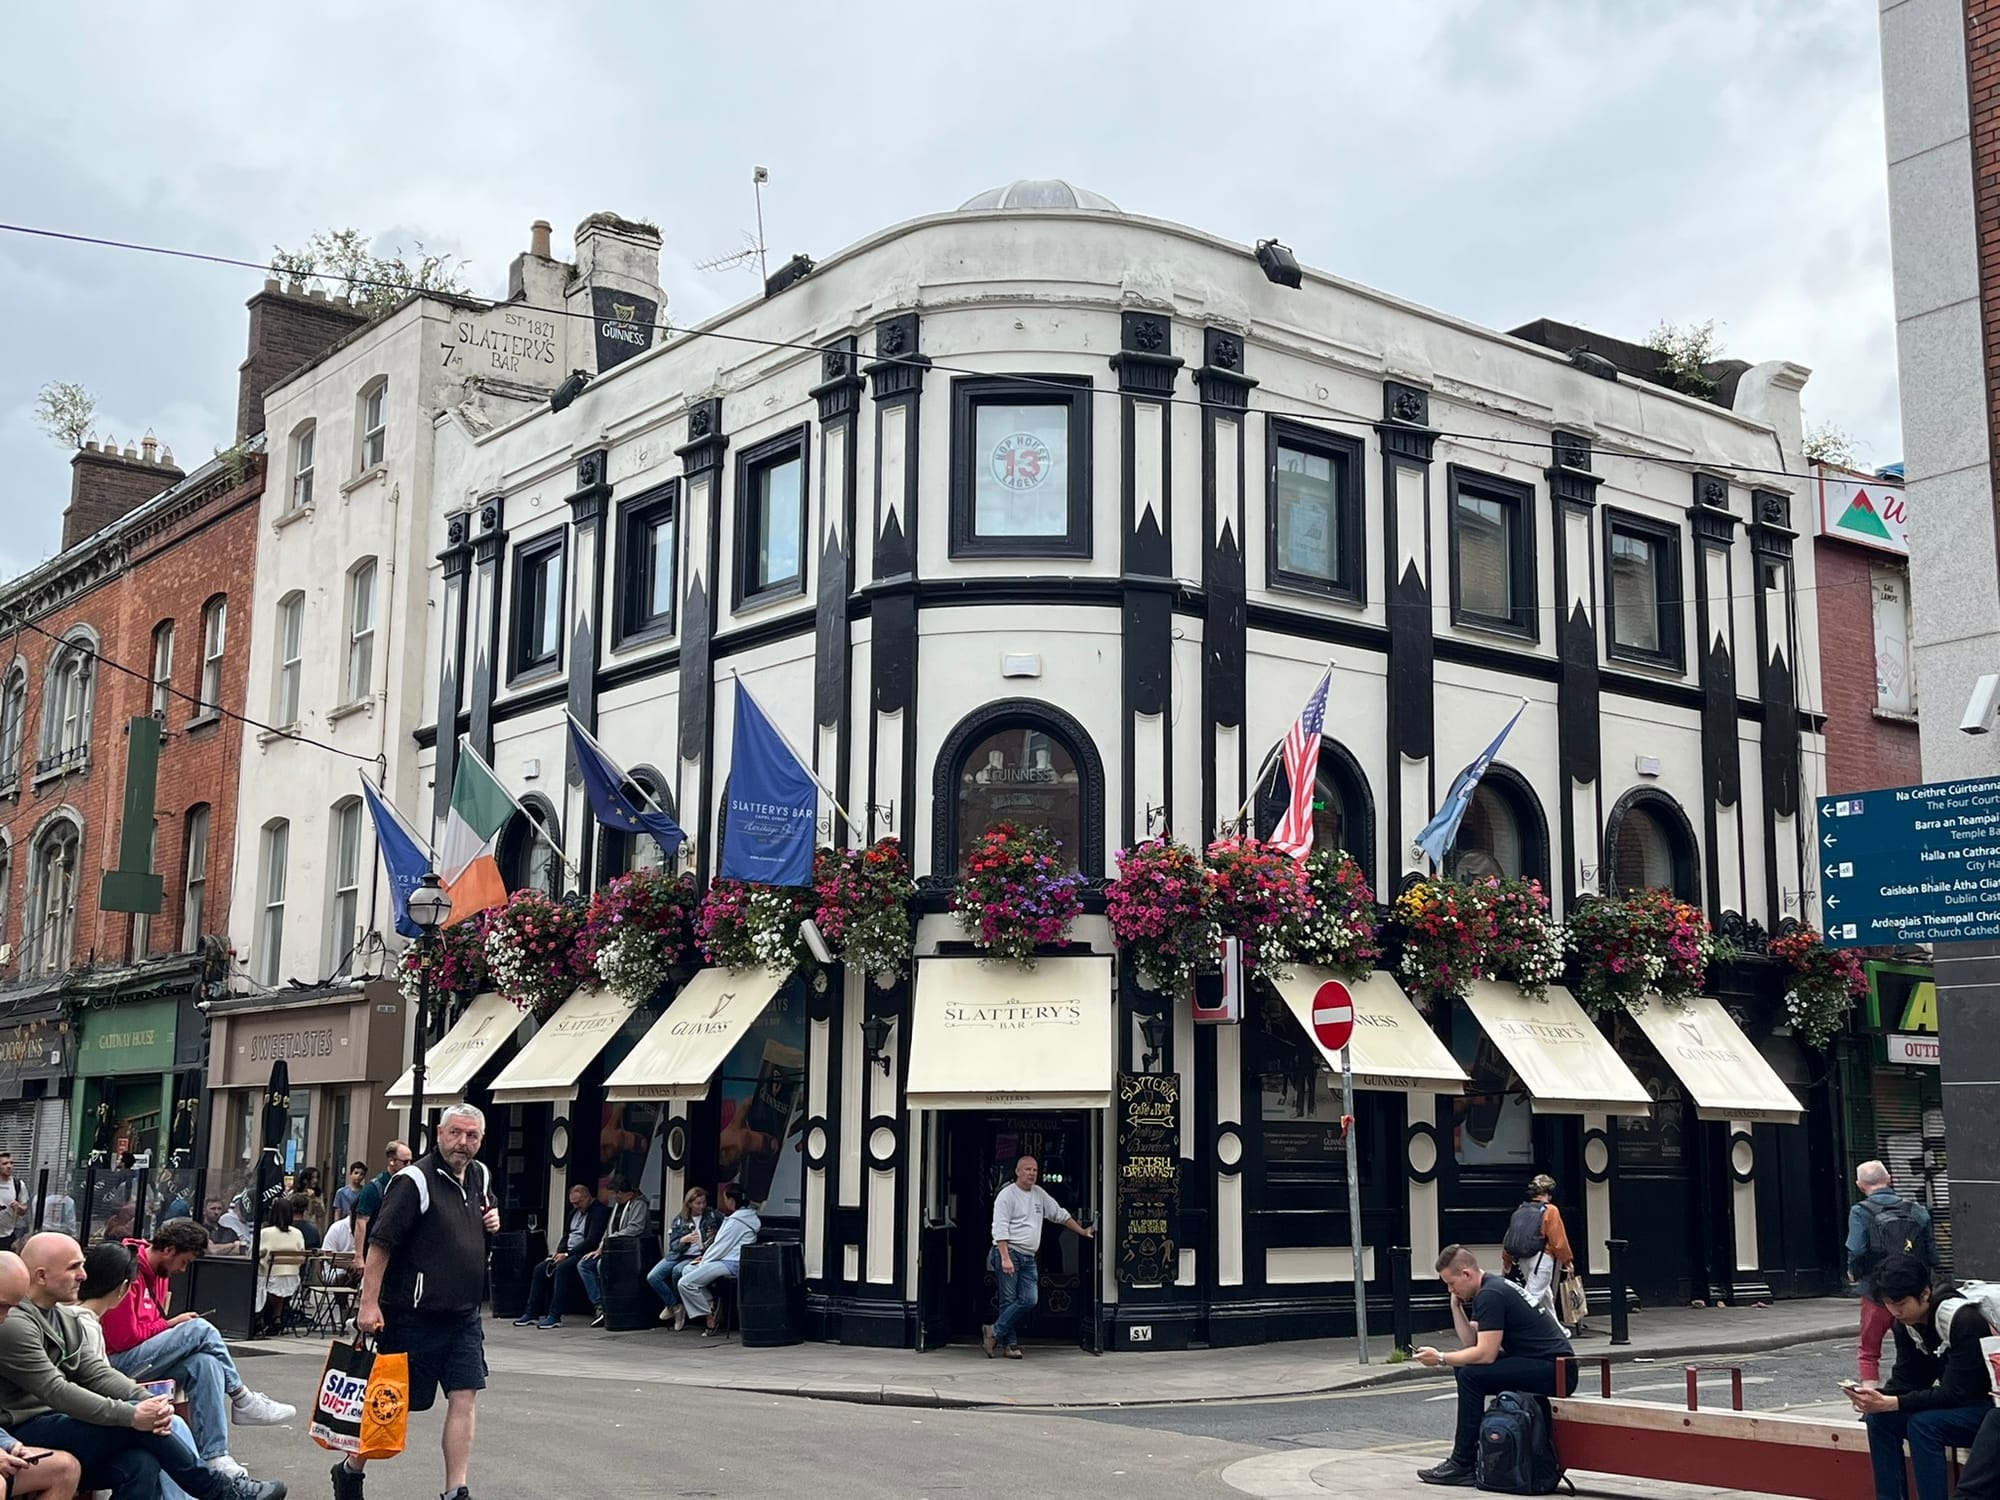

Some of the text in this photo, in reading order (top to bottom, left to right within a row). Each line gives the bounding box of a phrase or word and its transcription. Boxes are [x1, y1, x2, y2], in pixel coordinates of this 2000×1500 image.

[528, 320, 555, 339] 1821
[602, 323, 644, 346] GUINNESS
[458, 322, 556, 364] SLATTERY'S
[491, 352, 519, 373] BAR
[996, 436, 1048, 463] HOP HOUSE
[1003, 449, 1040, 477] 13
[1002, 474, 1039, 487] LAGER
[990, 768, 1050, 782] GUINNESS
[1896, 791, 1909, 801] Na
[1912, 788, 1946, 799] Ceithre
[732, 800, 813, 819] SLATTERY'S BAR
[1926, 801, 1944, 810] The
[1947, 798, 1969, 808] Four
[1915, 820, 1941, 830] Barra
[1943, 819, 1955, 827] an
[1951, 828, 1986, 840] Temple
[1920, 850, 1945, 861] Halla
[1948, 850, 1960, 859] na
[1966, 861, 1985, 872] City
[1880, 884, 1919, 896] Caisleán
[1921, 882, 1951, 893] Bhaile
[1953, 879, 1977, 891] Átha
[1945, 894, 1977, 904] Dublin
[1871, 915, 1921, 929] Ardeaglais
[1923, 912, 1974, 926] Theampall
[1898, 924, 1999, 940] Christ Church Cathed
[945, 1006, 1080, 1021] SLATTERY'S
[1899, 982, 1938, 1031] A
[556, 1016, 617, 1032] SLATTERY'S
[671, 1021, 728, 1036] GUINNESS
[1353, 1014, 1399, 1028] NNESS
[1499, 1024, 1584, 1039] SLATTERY'S
[99, 1030, 155, 1049] GATEWAY HOUSE
[251, 1029, 333, 1062] SWEETASTES
[1676, 1046, 1742, 1063] GUINNESS
[1363, 1075, 1409, 1088] GUINNESS
[1129, 1157, 1171, 1168] IRISH
[1123, 1166, 1175, 1178] BREAKFAST
[1133, 1329, 1148, 1340] SV
